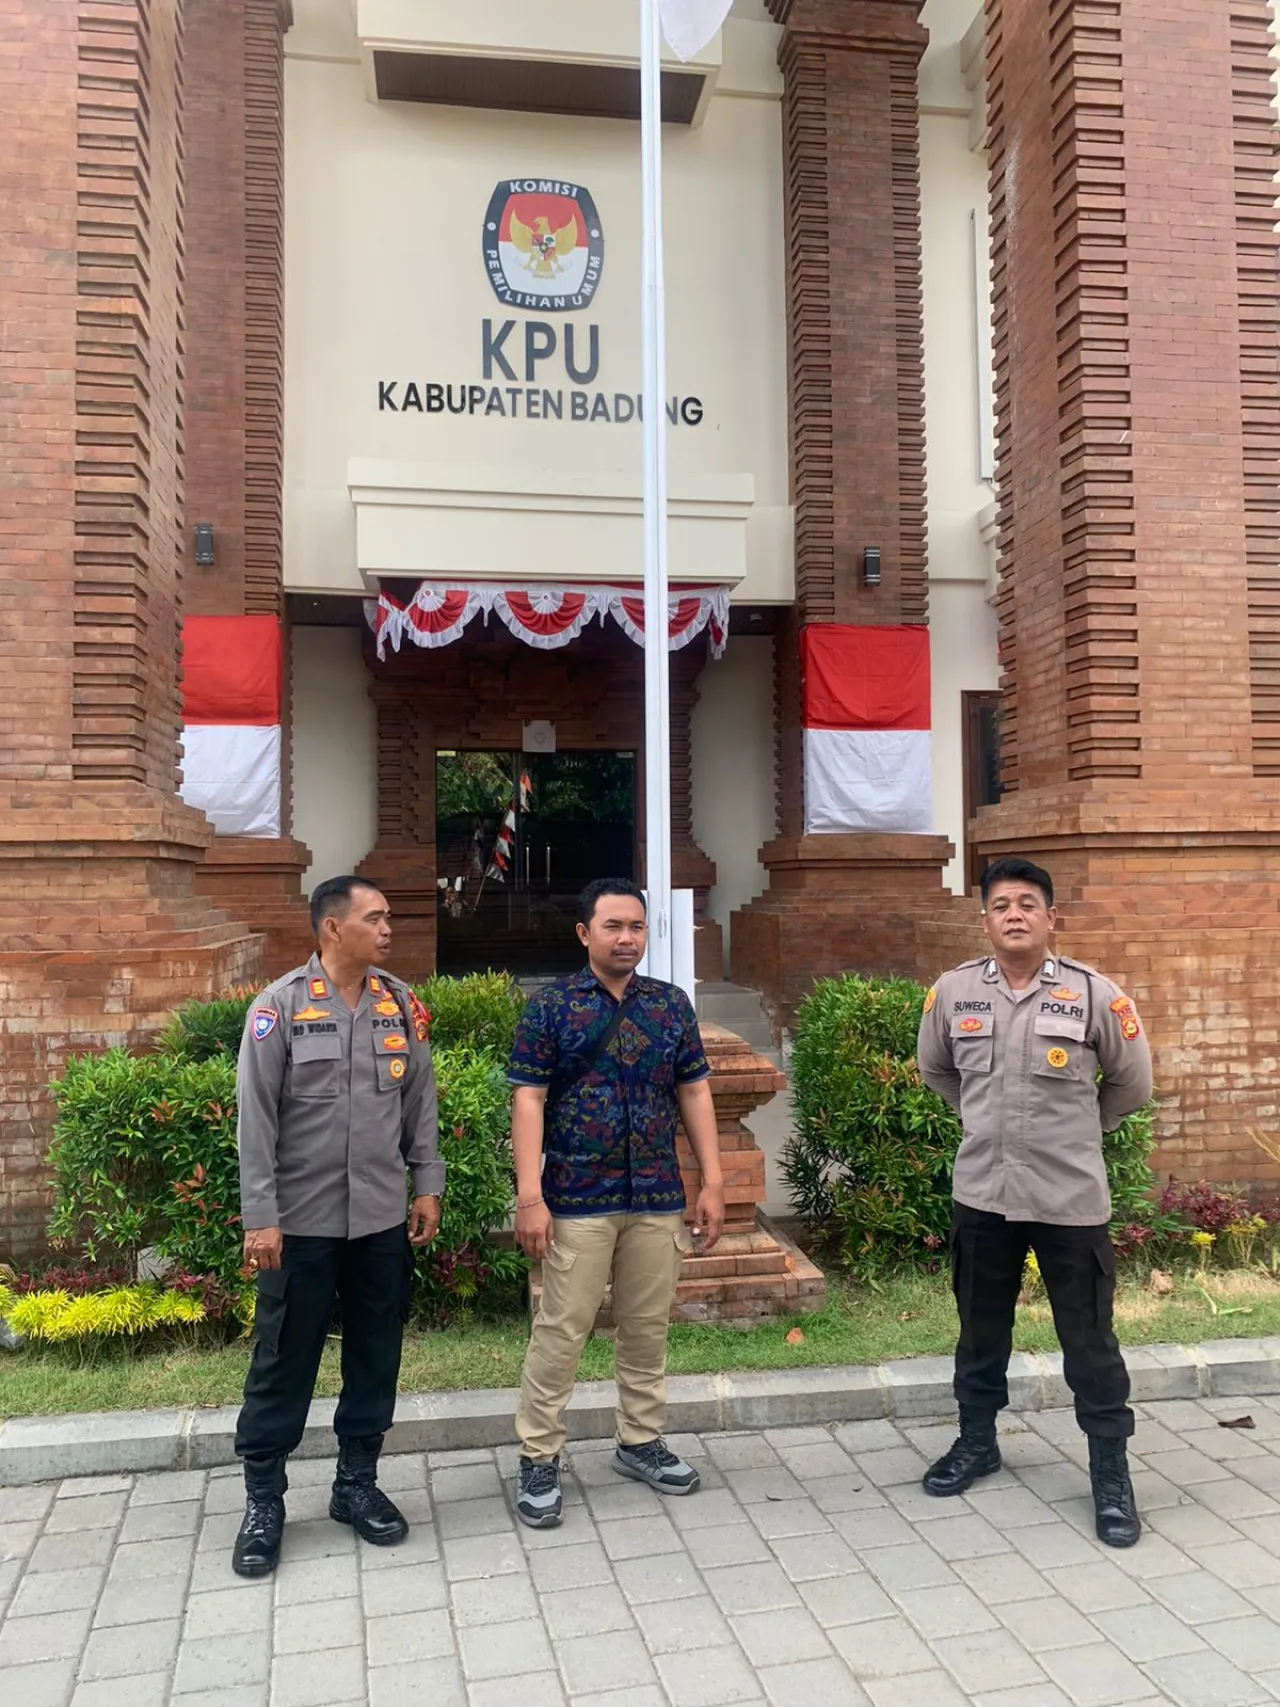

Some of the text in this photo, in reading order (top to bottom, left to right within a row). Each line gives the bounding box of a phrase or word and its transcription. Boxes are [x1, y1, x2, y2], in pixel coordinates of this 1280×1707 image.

[510, 181, 578, 198] KOMISI
[486, 250, 601, 307] PEMILIHAN UMUM
[482, 318, 600, 385] KPU
[378, 381, 563, 420] KABUPATEN
[954, 1001, 992, 1012] SUWECA
[1040, 1002, 1084, 1018] POLRI
